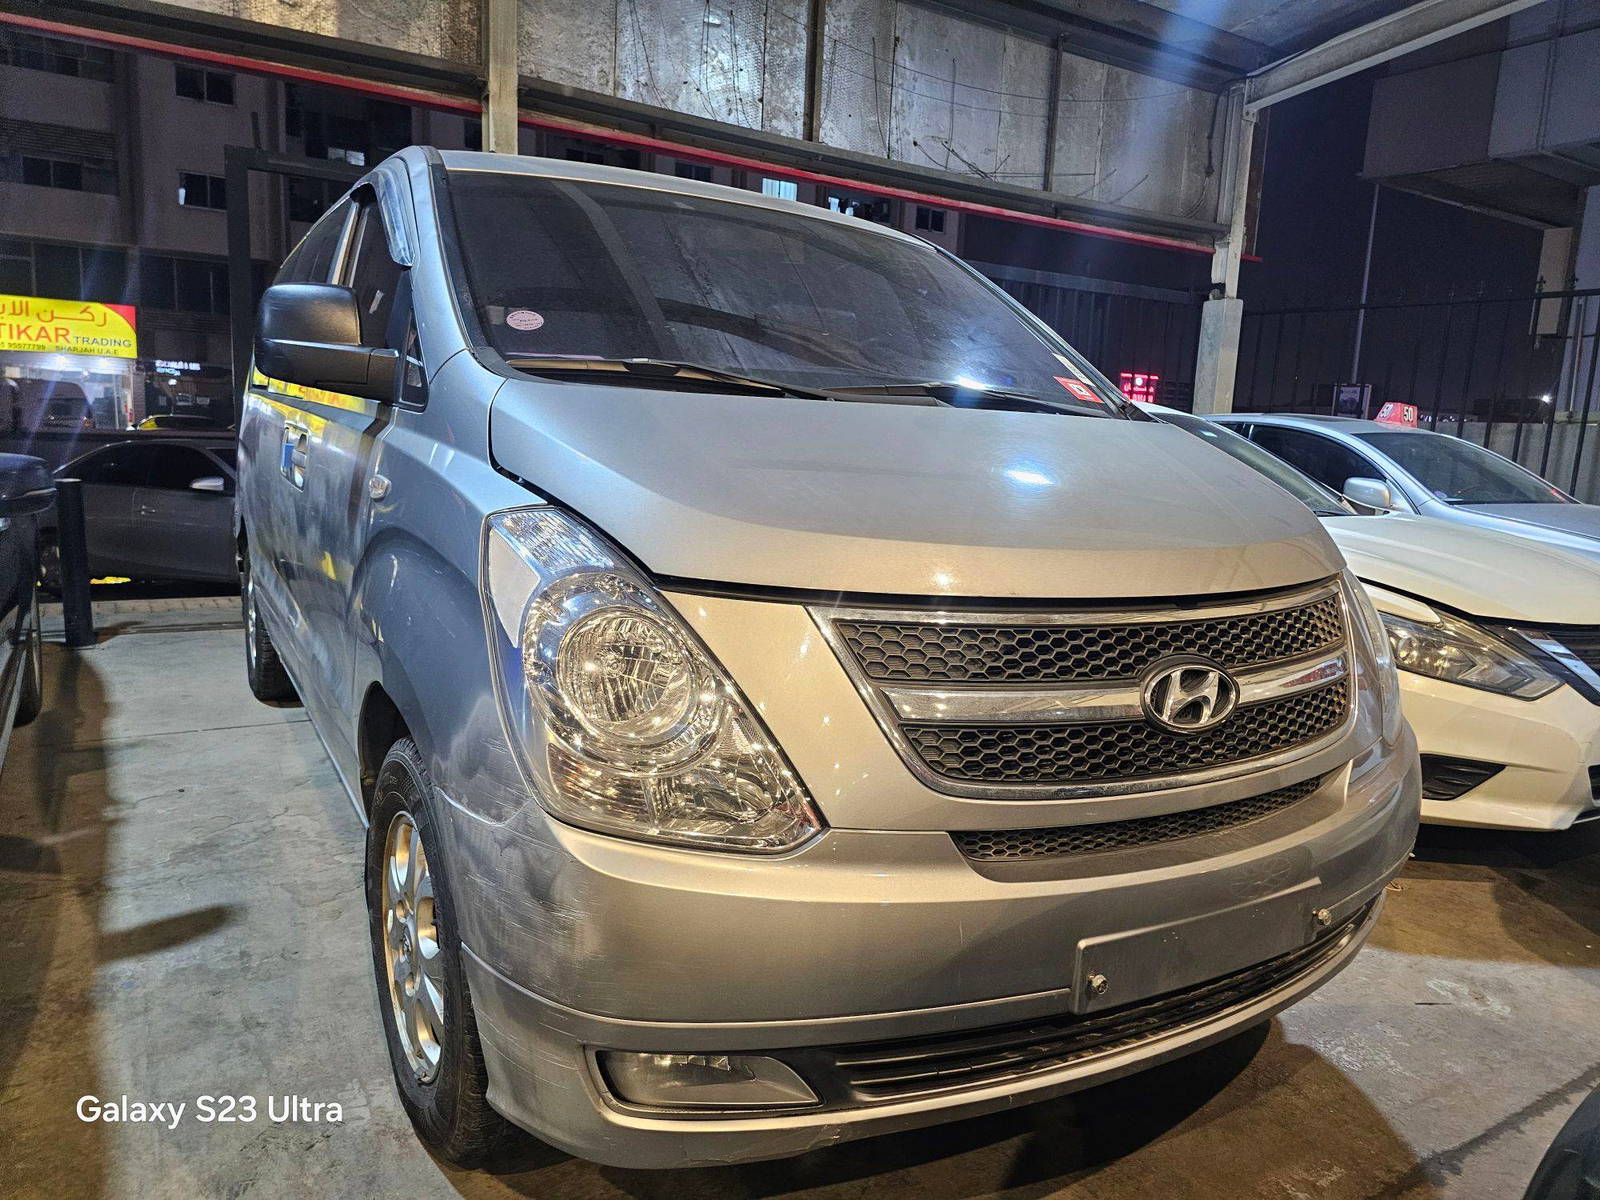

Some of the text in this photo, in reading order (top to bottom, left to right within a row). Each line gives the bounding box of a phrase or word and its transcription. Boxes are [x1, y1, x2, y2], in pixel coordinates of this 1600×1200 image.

[36, 305, 107, 327] ركن
[73, 335, 132, 348] TRADING
[1403, 406, 1414, 423] 50
